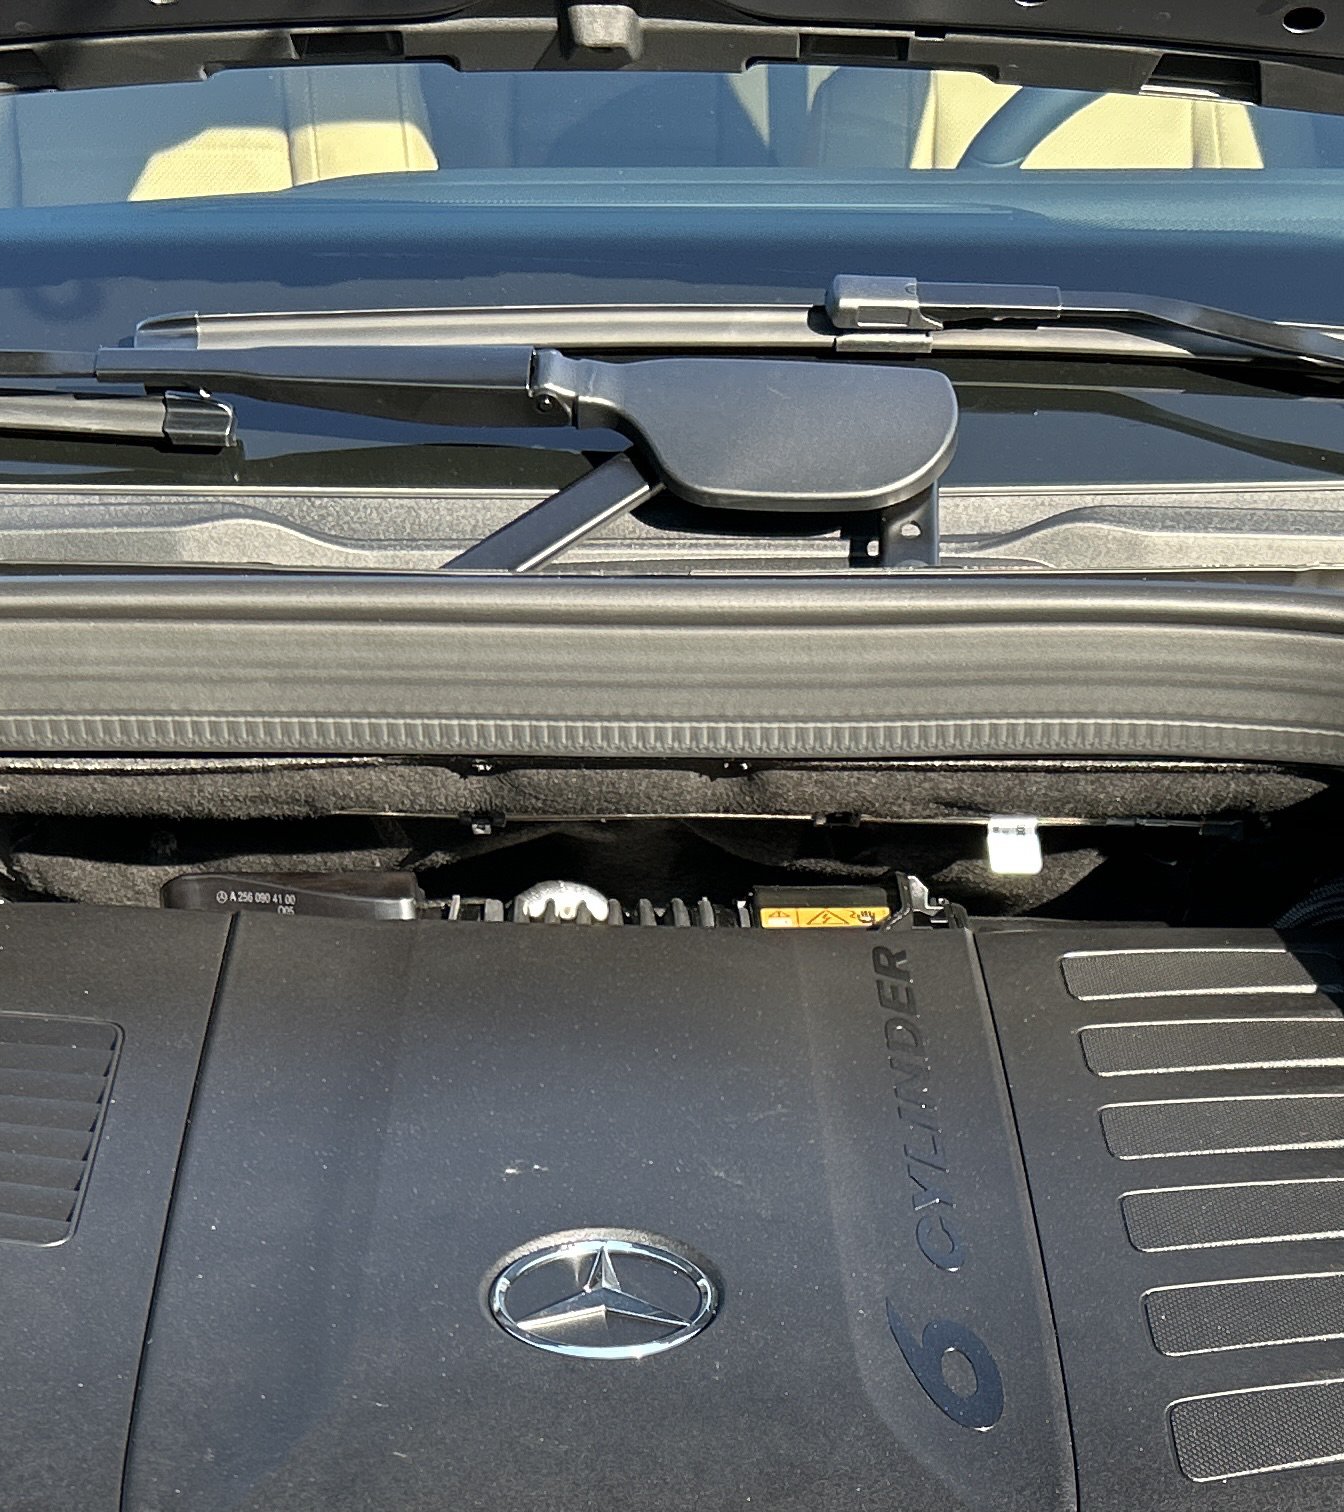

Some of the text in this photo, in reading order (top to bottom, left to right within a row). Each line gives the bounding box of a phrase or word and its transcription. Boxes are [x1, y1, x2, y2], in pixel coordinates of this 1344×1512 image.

[229, 891, 237, 902] A
[238, 892, 253, 903] 256
[272, 893, 282, 904] 41
[285, 894, 296, 905] 00
[872, 945, 1004, 1432] 6 CYLINDER
